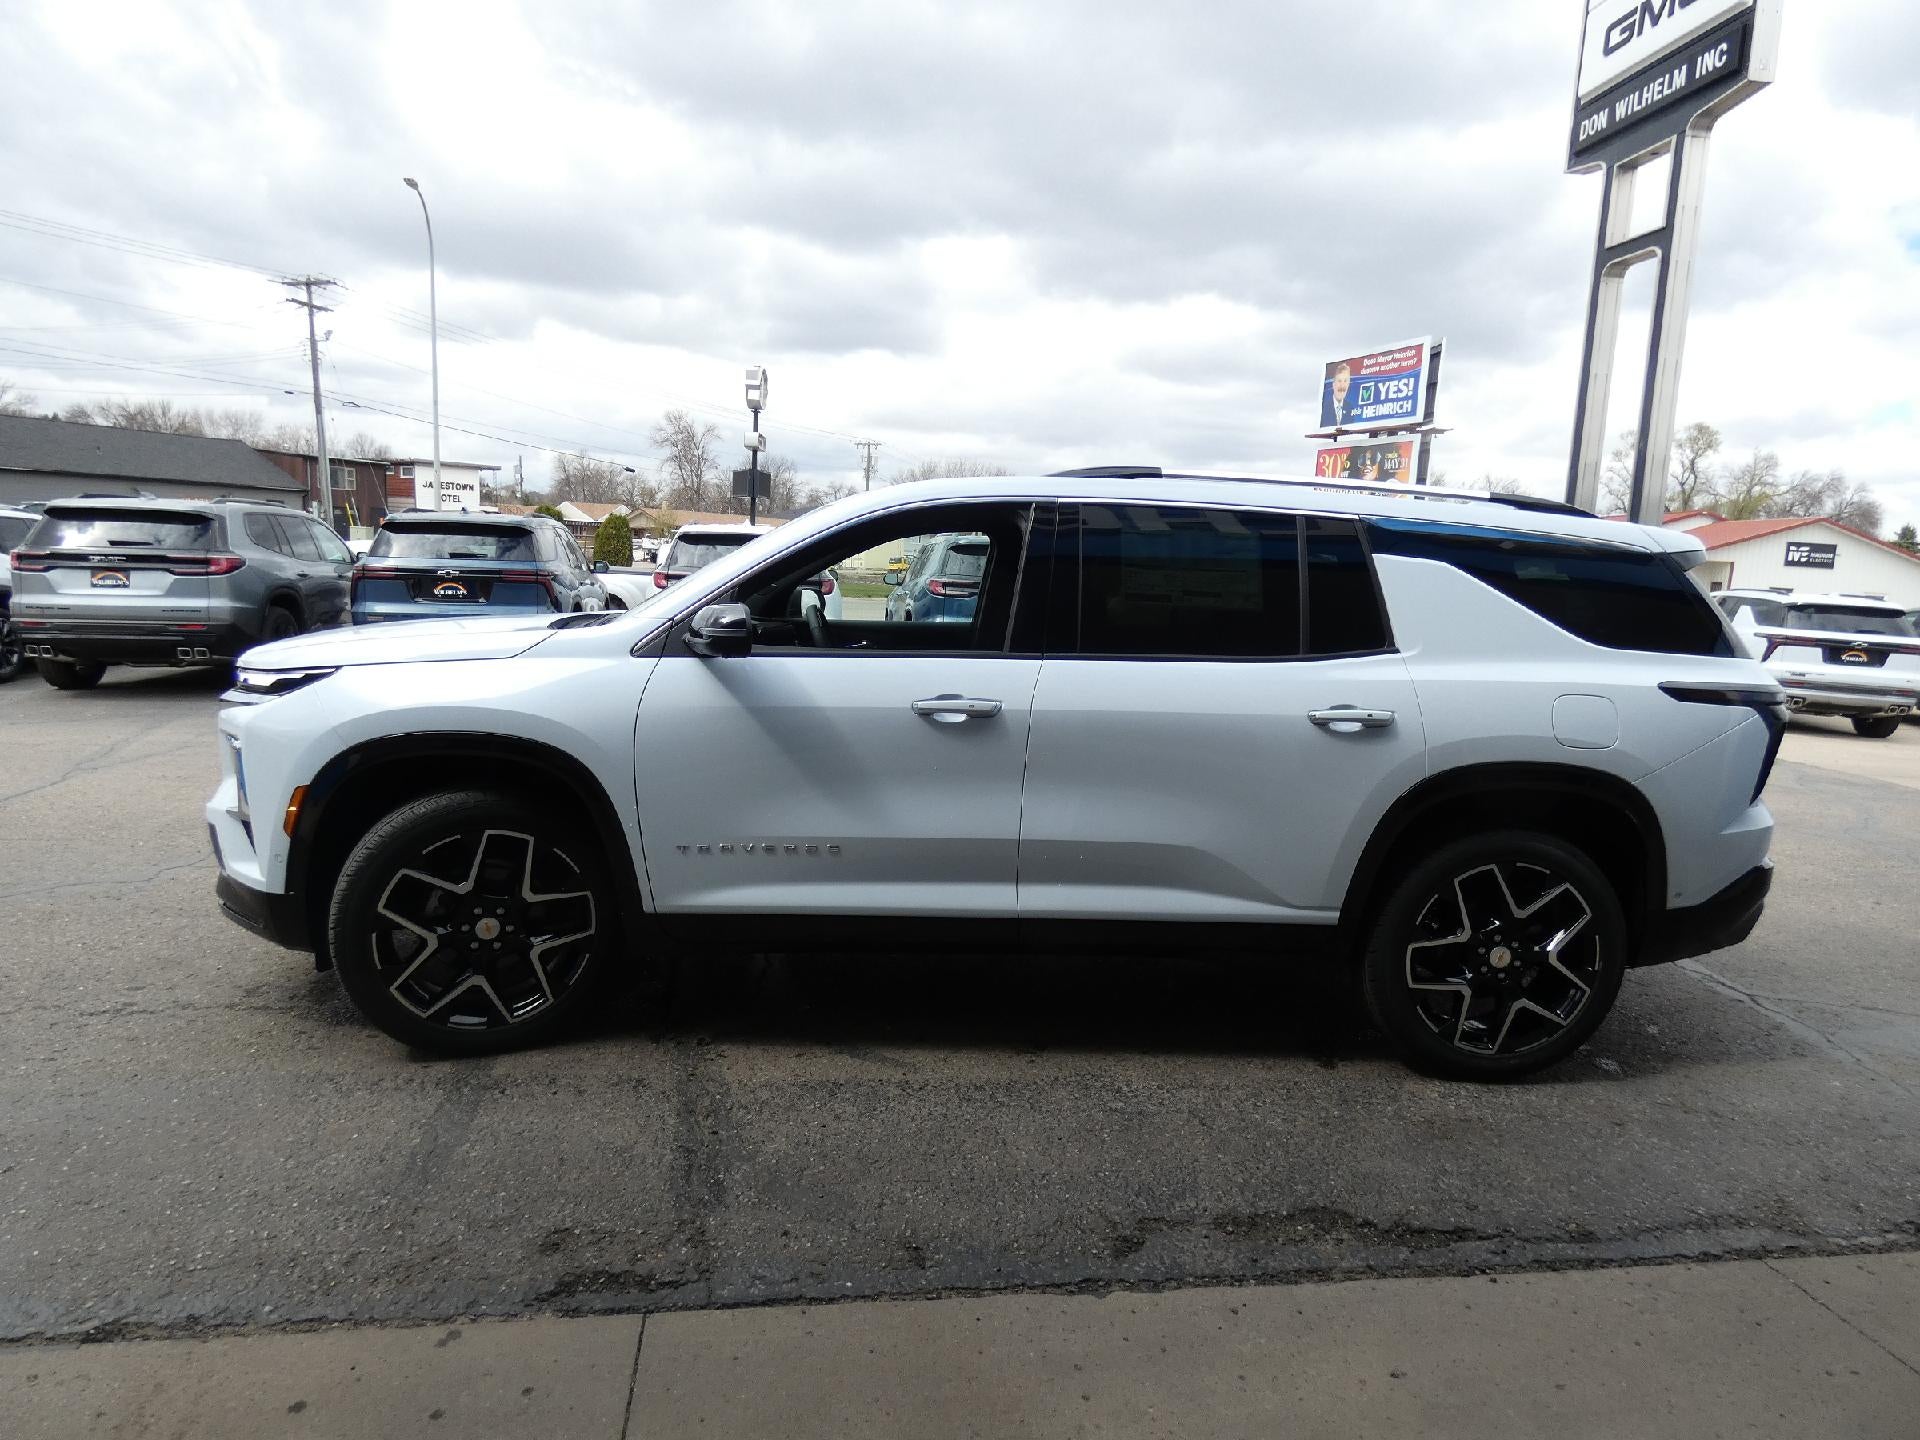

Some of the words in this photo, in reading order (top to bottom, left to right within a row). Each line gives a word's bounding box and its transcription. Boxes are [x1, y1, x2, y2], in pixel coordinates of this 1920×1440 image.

[1603, 0, 1698, 57] GM
[1579, 108, 1609, 142] DON
[1615, 64, 1687, 122] WILHELM
[1695, 43, 1728, 80] INC
[1380, 361, 1401, 372] another
[1377, 377, 1415, 401] YES!
[1362, 400, 1412, 418] HEINRICH
[422, 481, 475, 492] JAESTOWN
[440, 493, 462, 503] OTEL
[676, 843, 841, 856] TRAVERSE
